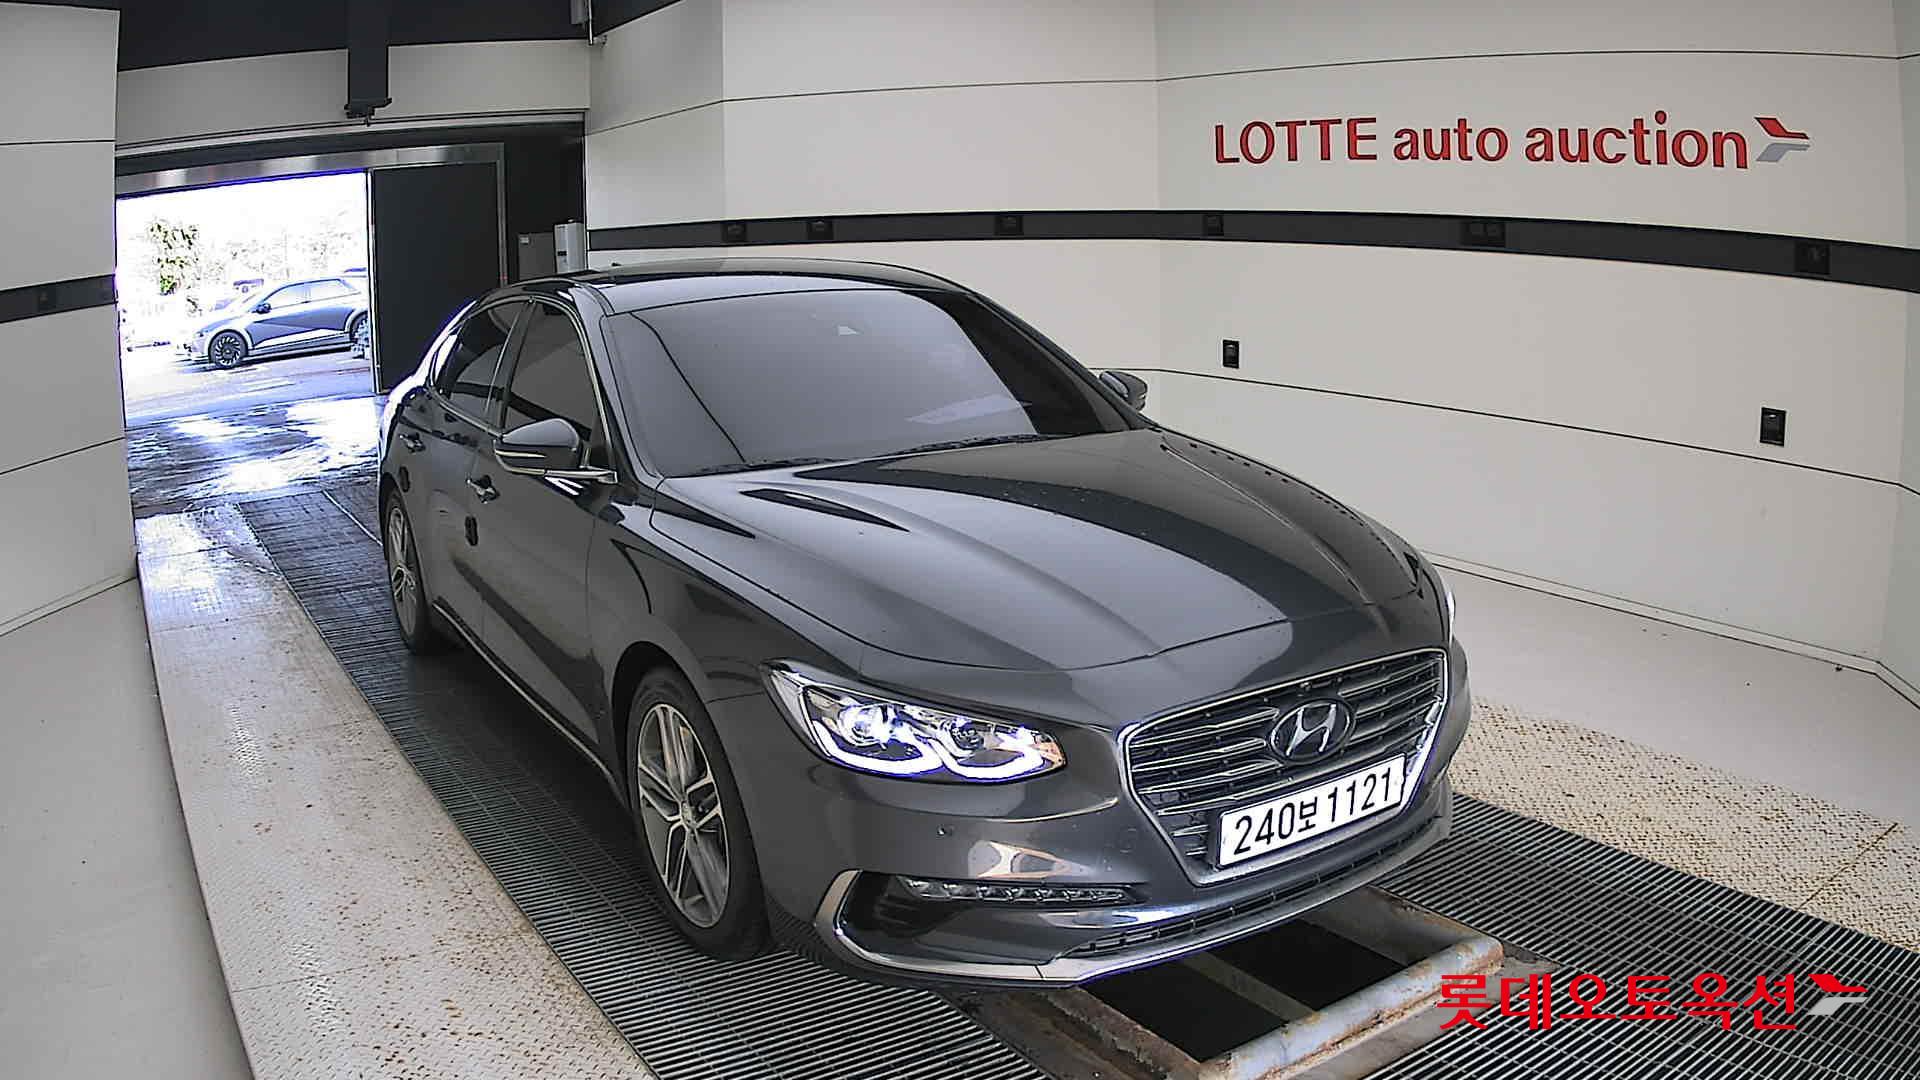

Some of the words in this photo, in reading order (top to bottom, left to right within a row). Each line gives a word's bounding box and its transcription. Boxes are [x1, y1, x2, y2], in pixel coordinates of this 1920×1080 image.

[1214, 116, 1377, 164] LOTTE
[1392, 118, 1509, 162] auto
[1524, 110, 1749, 169] auction
